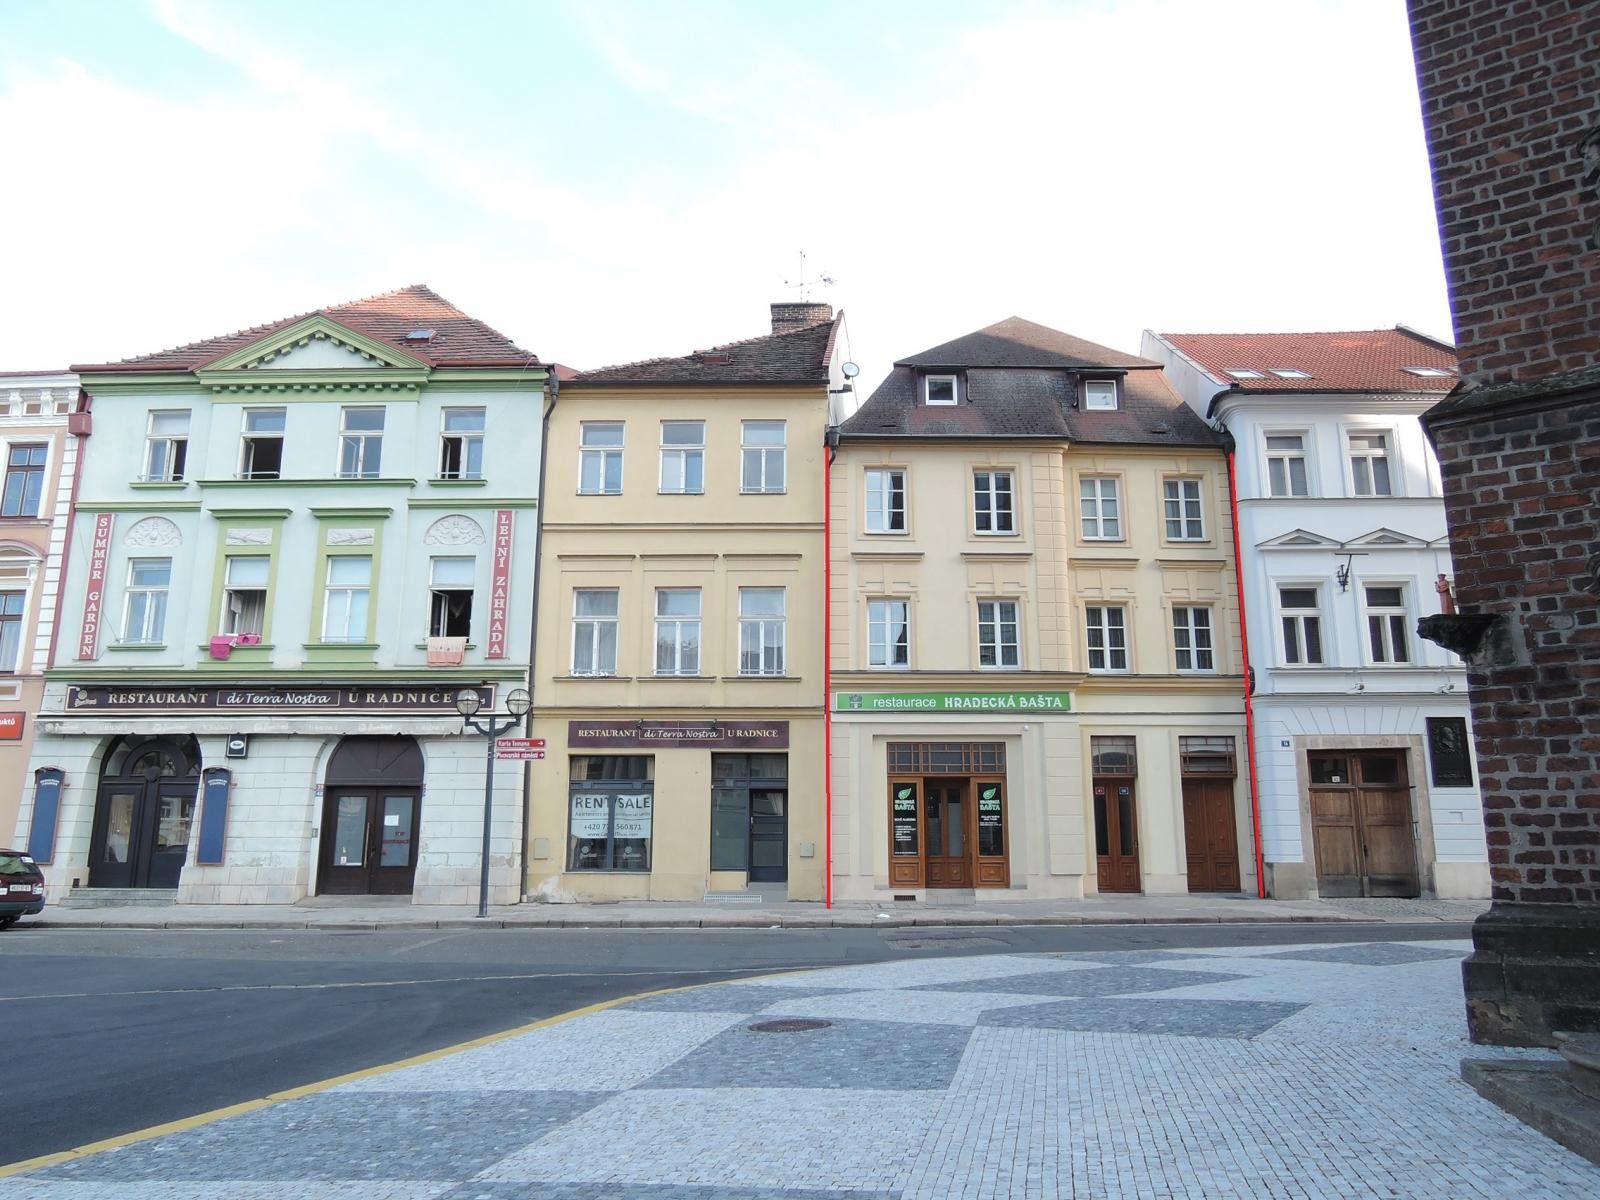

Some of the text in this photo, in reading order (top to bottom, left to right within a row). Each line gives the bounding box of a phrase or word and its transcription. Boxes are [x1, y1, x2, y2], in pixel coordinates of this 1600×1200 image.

[81, 517, 108, 655] SUMMER GARDEN
[490, 577, 506, 653] ZAHRADA
[108, 693, 209, 704] RESTAURANT
[226, 692, 243, 704] di
[245, 693, 283, 704] Terra
[284, 692, 331, 705] Nostra
[348, 693, 359, 703] U
[366, 693, 453, 703] RADNICE
[873, 694, 1063, 708] restaurace HRADECKÁ BAŠTA
[578, 729, 779, 739] RESTAURANT di Terra Nostra U RADNICE
